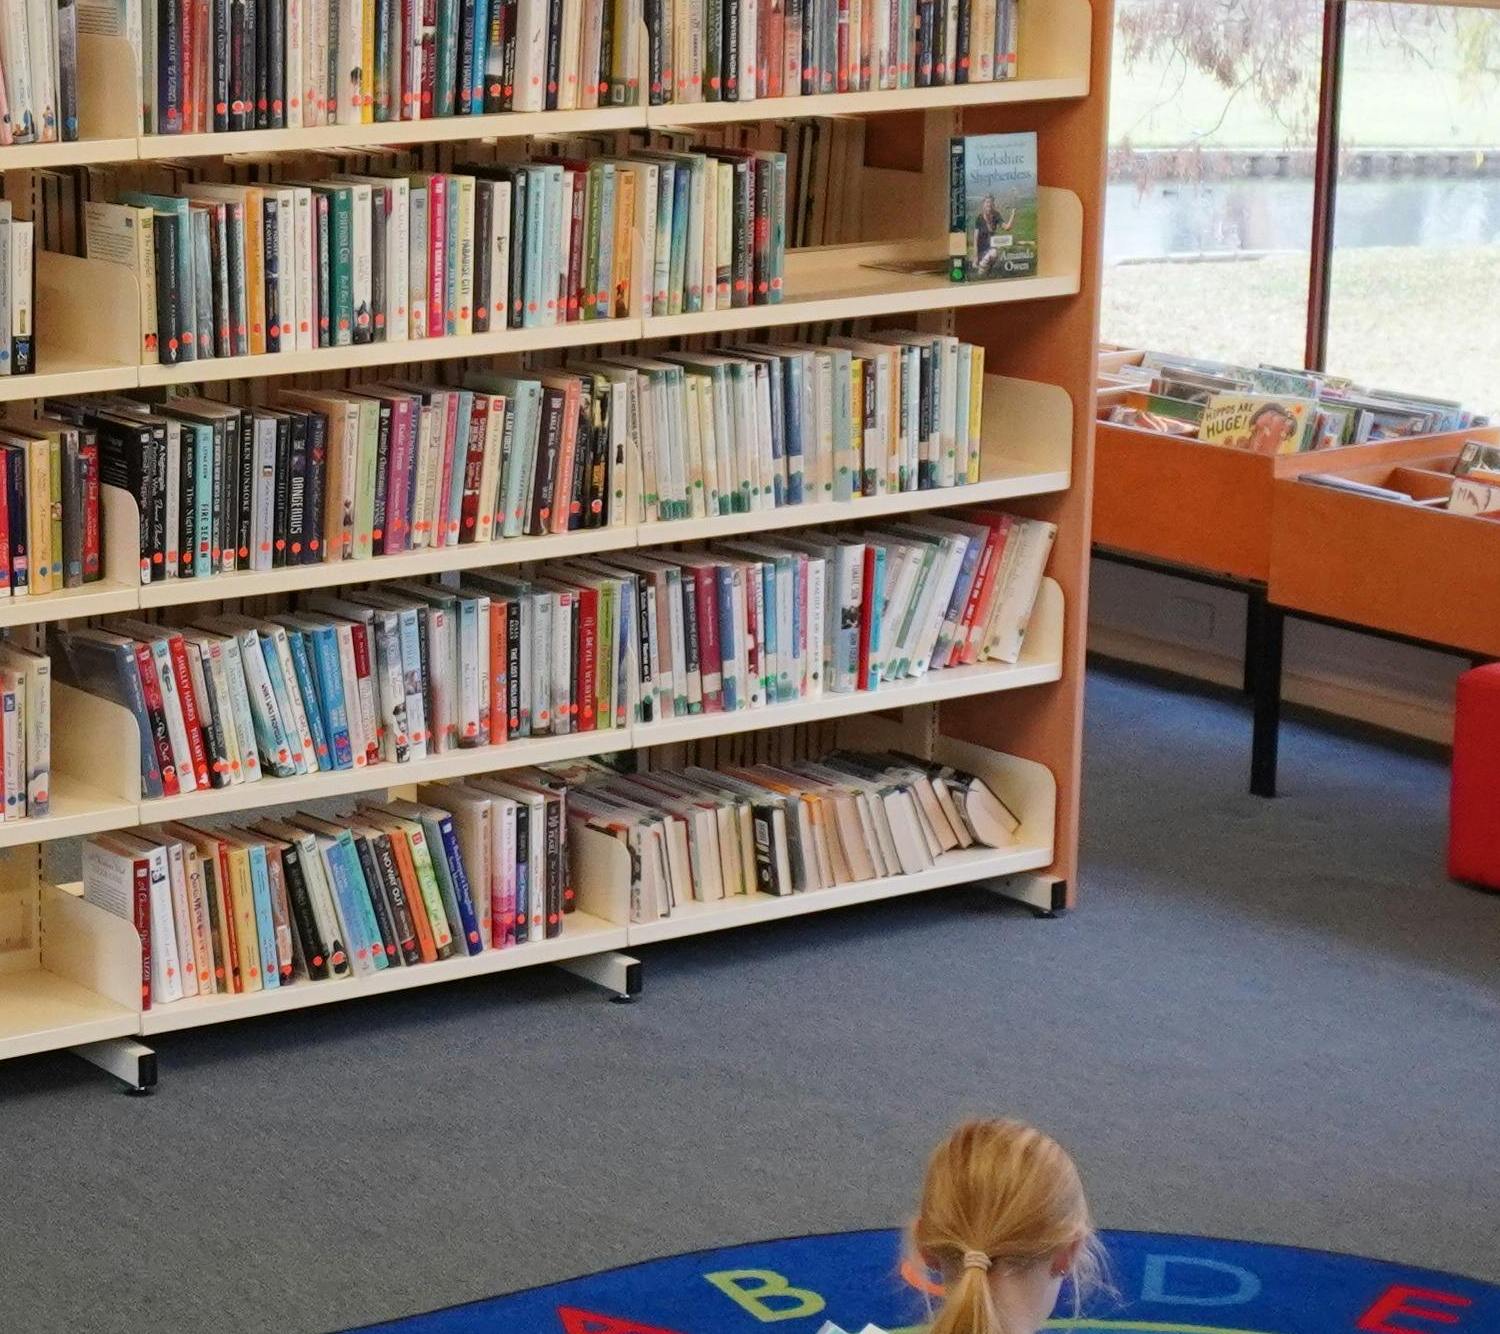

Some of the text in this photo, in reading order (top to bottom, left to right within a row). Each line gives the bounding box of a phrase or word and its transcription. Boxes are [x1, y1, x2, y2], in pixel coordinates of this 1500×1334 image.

[1205, 402, 1255, 424] HIPPOS ARE
[1206, 415, 1250, 437] HUGE!
[199, 526, 209, 558] SEAN
[705, 1269, 825, 1322] B
[1141, 1254, 1260, 1307] D
